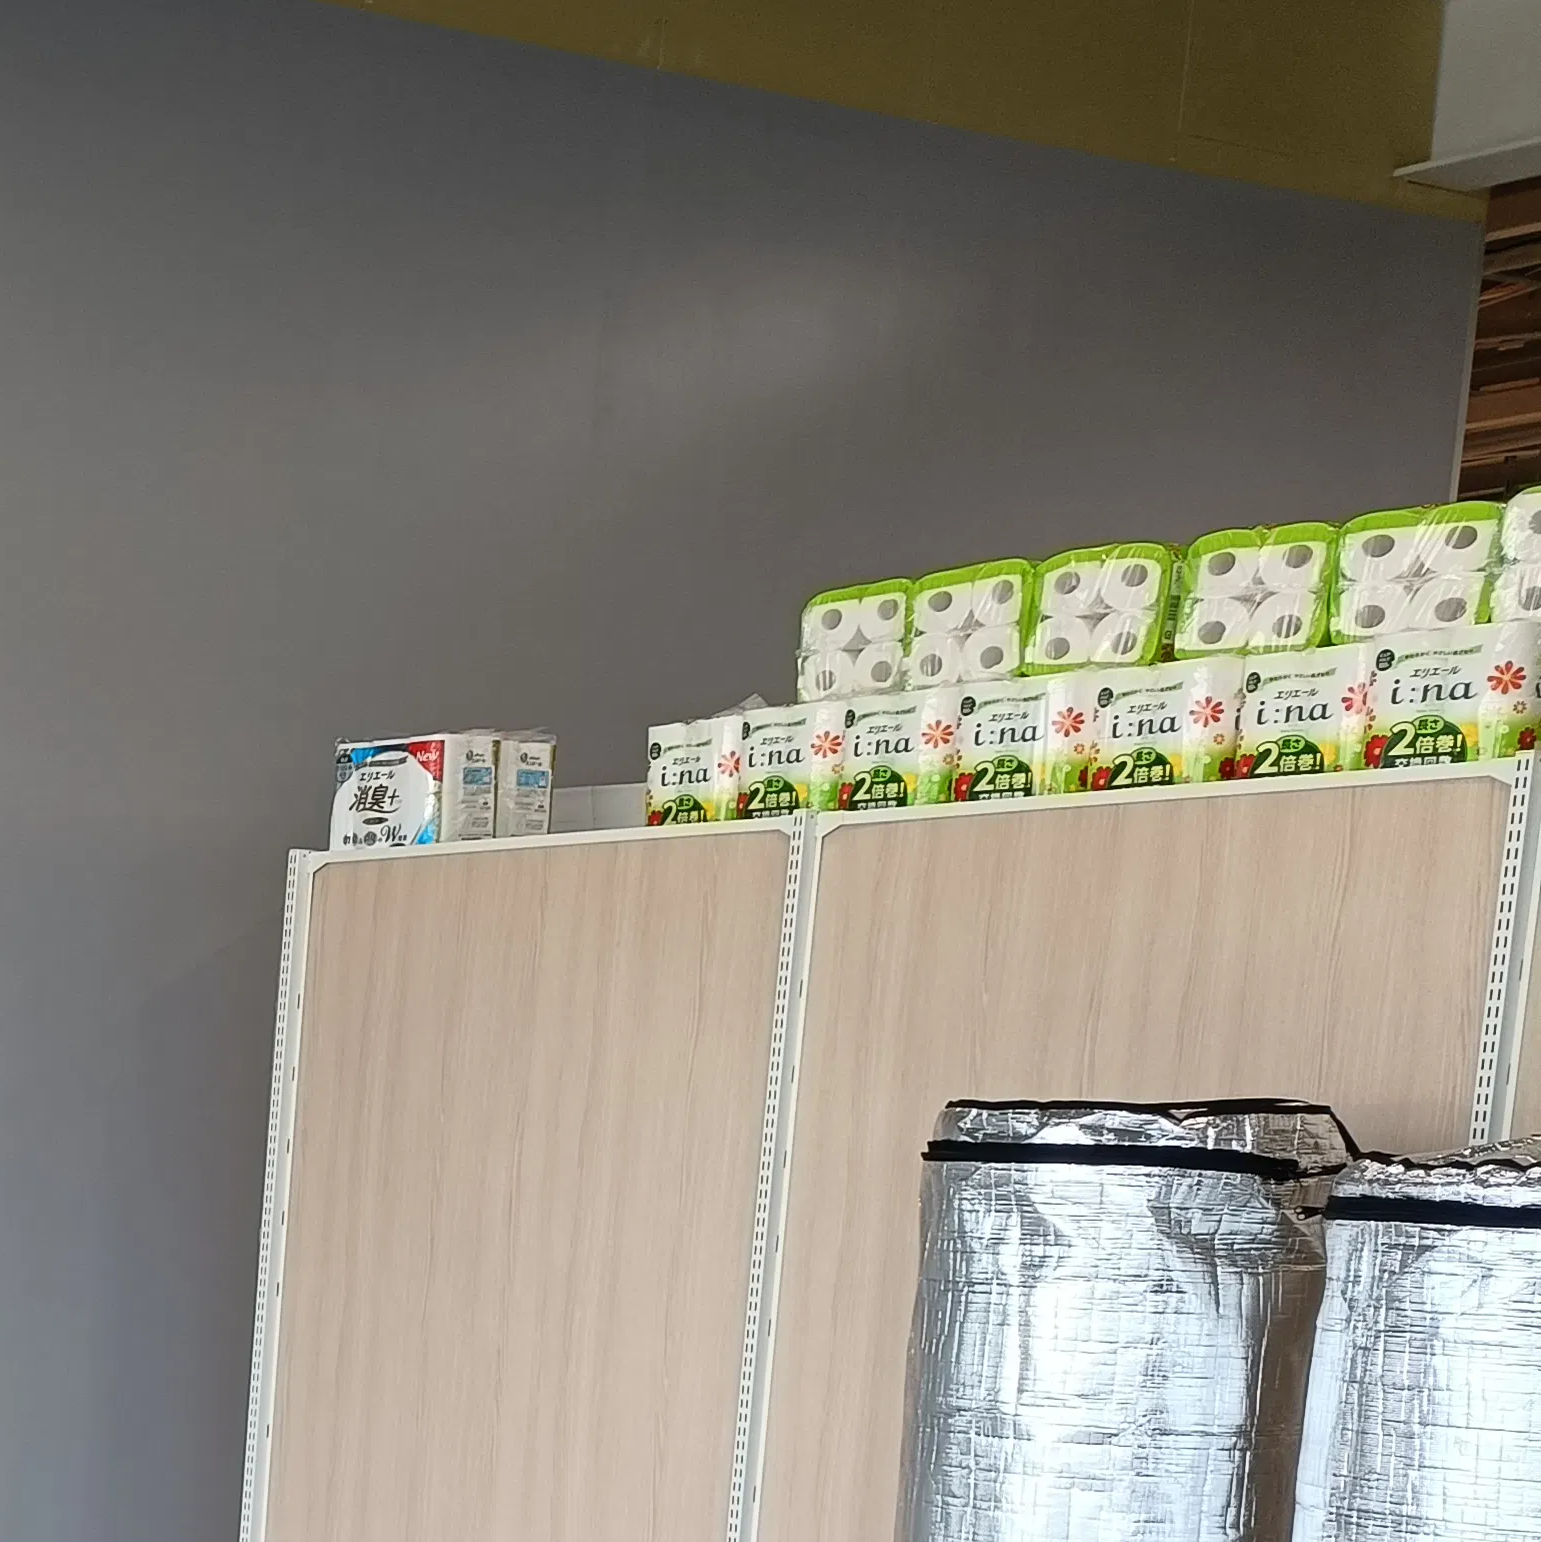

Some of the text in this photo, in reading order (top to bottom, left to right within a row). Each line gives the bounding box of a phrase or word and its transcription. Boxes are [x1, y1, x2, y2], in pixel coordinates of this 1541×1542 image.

[1409, 665, 1461, 679] エリエール
[1274, 688, 1319, 700] エリエール
[1390, 678, 1477, 705] i:na
[988, 711, 1030, 722] エリエール
[1127, 701, 1168, 715] エリエール
[1256, 700, 1334, 725] i:na
[866, 723, 903, 735] エリエール
[974, 723, 1046, 746] i:na
[1112, 714, 1181, 739] i:na
[853, 735, 915, 757] i:na
[1387, 722, 1463, 756] 2倍巻!
[748, 746, 806, 768] i:na
[360, 770, 396, 783] エリエール
[661, 766, 711, 787] i:na
